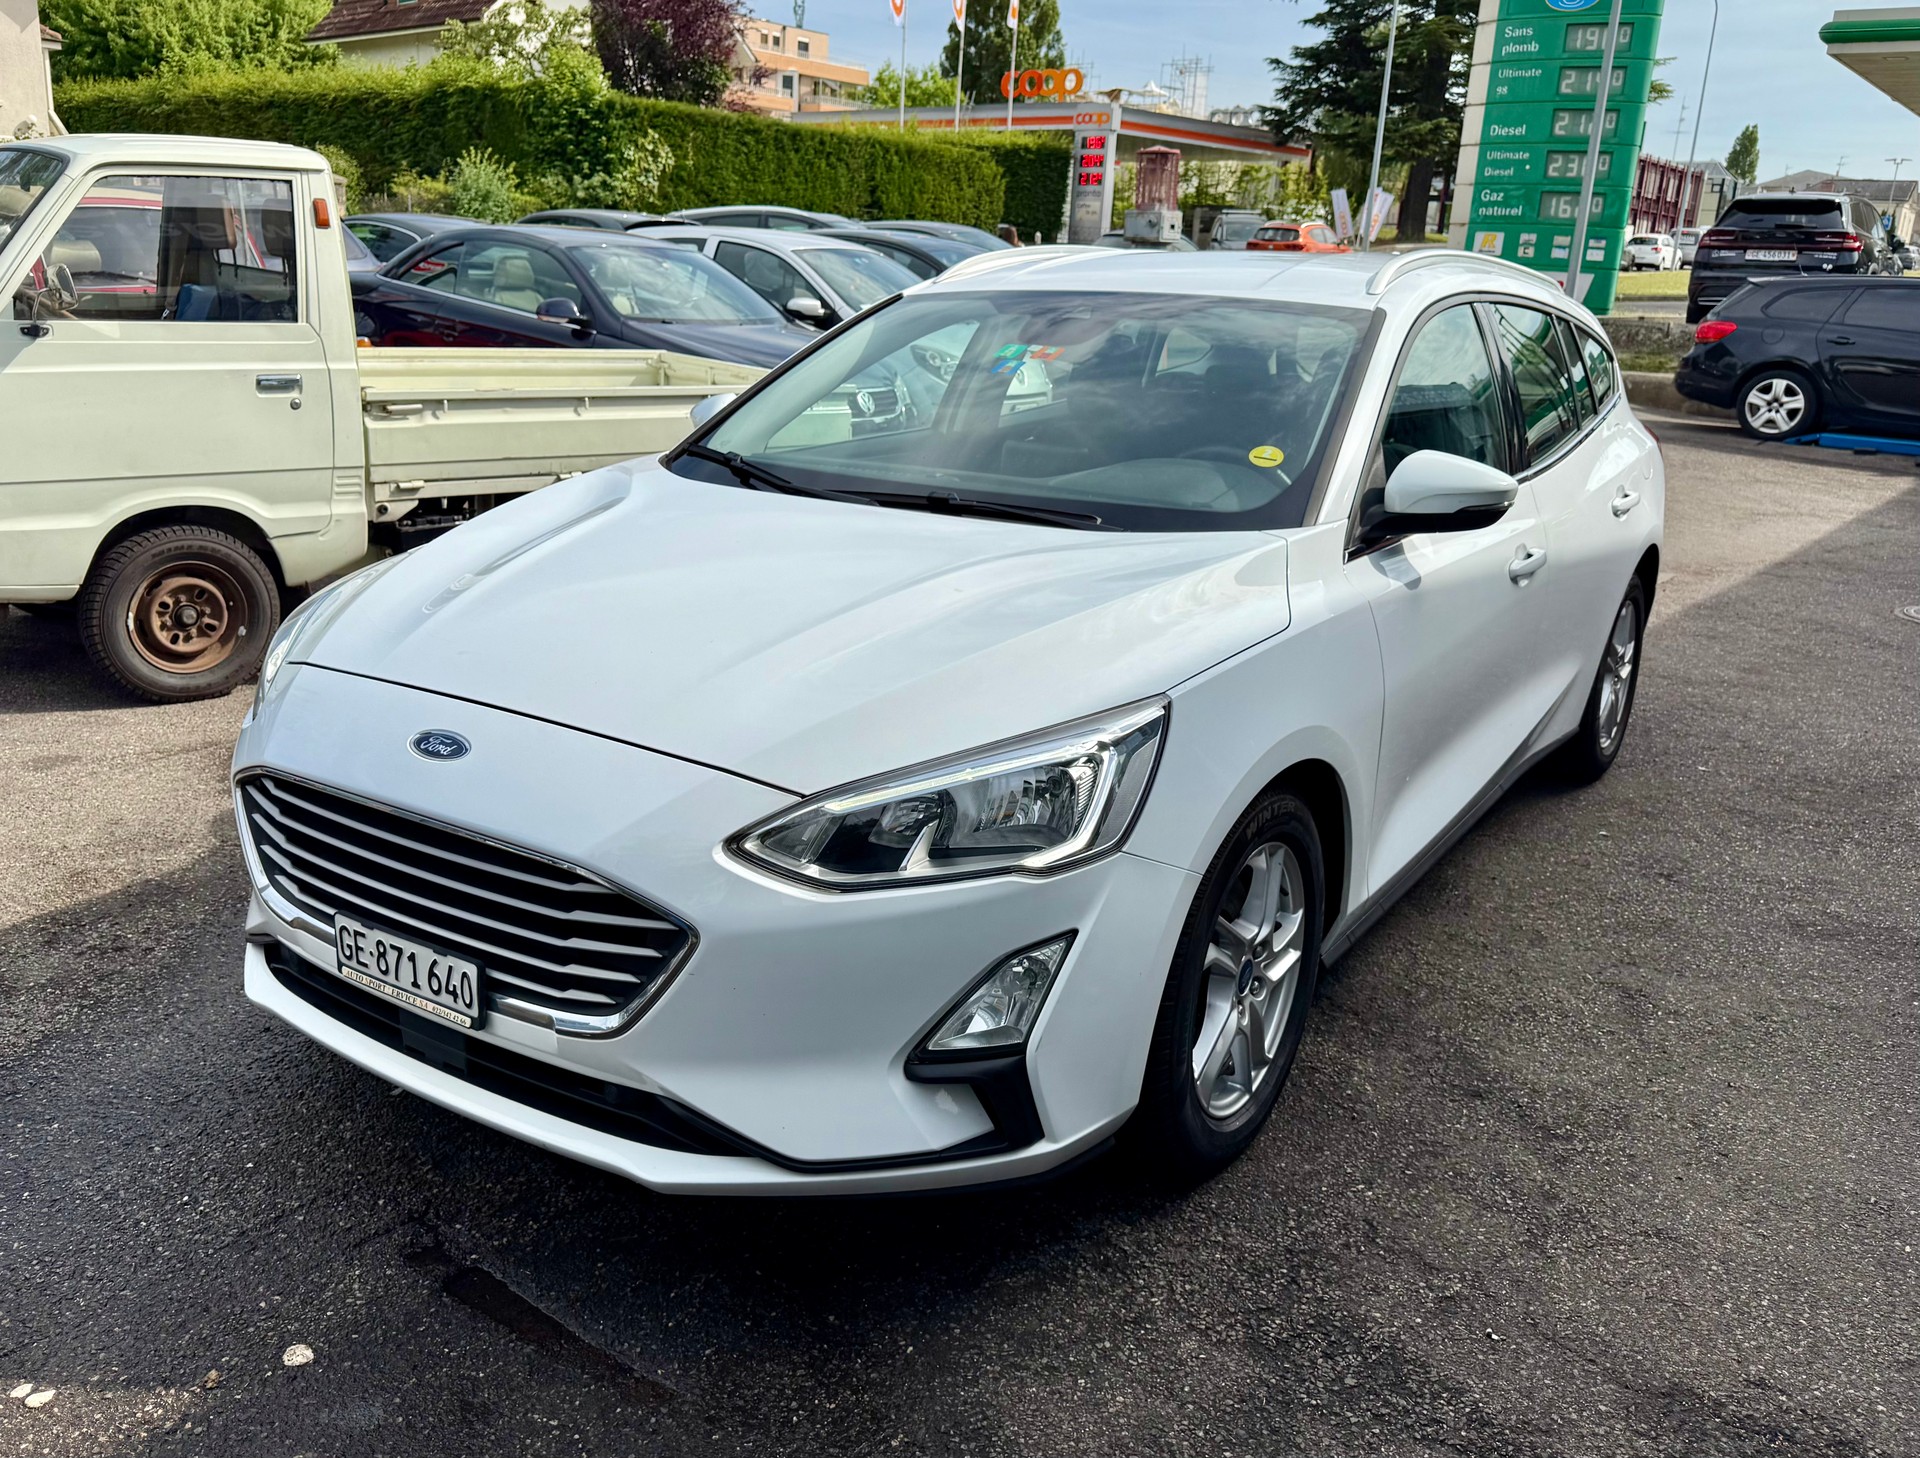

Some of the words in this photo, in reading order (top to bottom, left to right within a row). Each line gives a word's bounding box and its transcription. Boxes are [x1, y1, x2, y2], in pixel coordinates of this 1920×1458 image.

[1504, 25, 1533, 37] Sans
[1501, 41, 1540, 55] plomb
[1498, 67, 1543, 78] Ultimate
[1001, 68, 1083, 102] coop
[1496, 85, 1508, 96] 98
[1075, 113, 1110, 127] coop
[1490, 124, 1526, 136] Diesel
[1485, 150, 1530, 161] Ultimate
[1483, 165, 1514, 177] Diesel
[1481, 189, 1504, 202] Gaz
[1478, 203, 1523, 216] naturel
[420, 735, 457, 756] Ford
[1245, 802, 1296, 840] WINTER
[346, 970, 364, 982] AUTO
[364, 977, 386, 992] SPORT
[387, 987, 418, 1005] ERVICE
